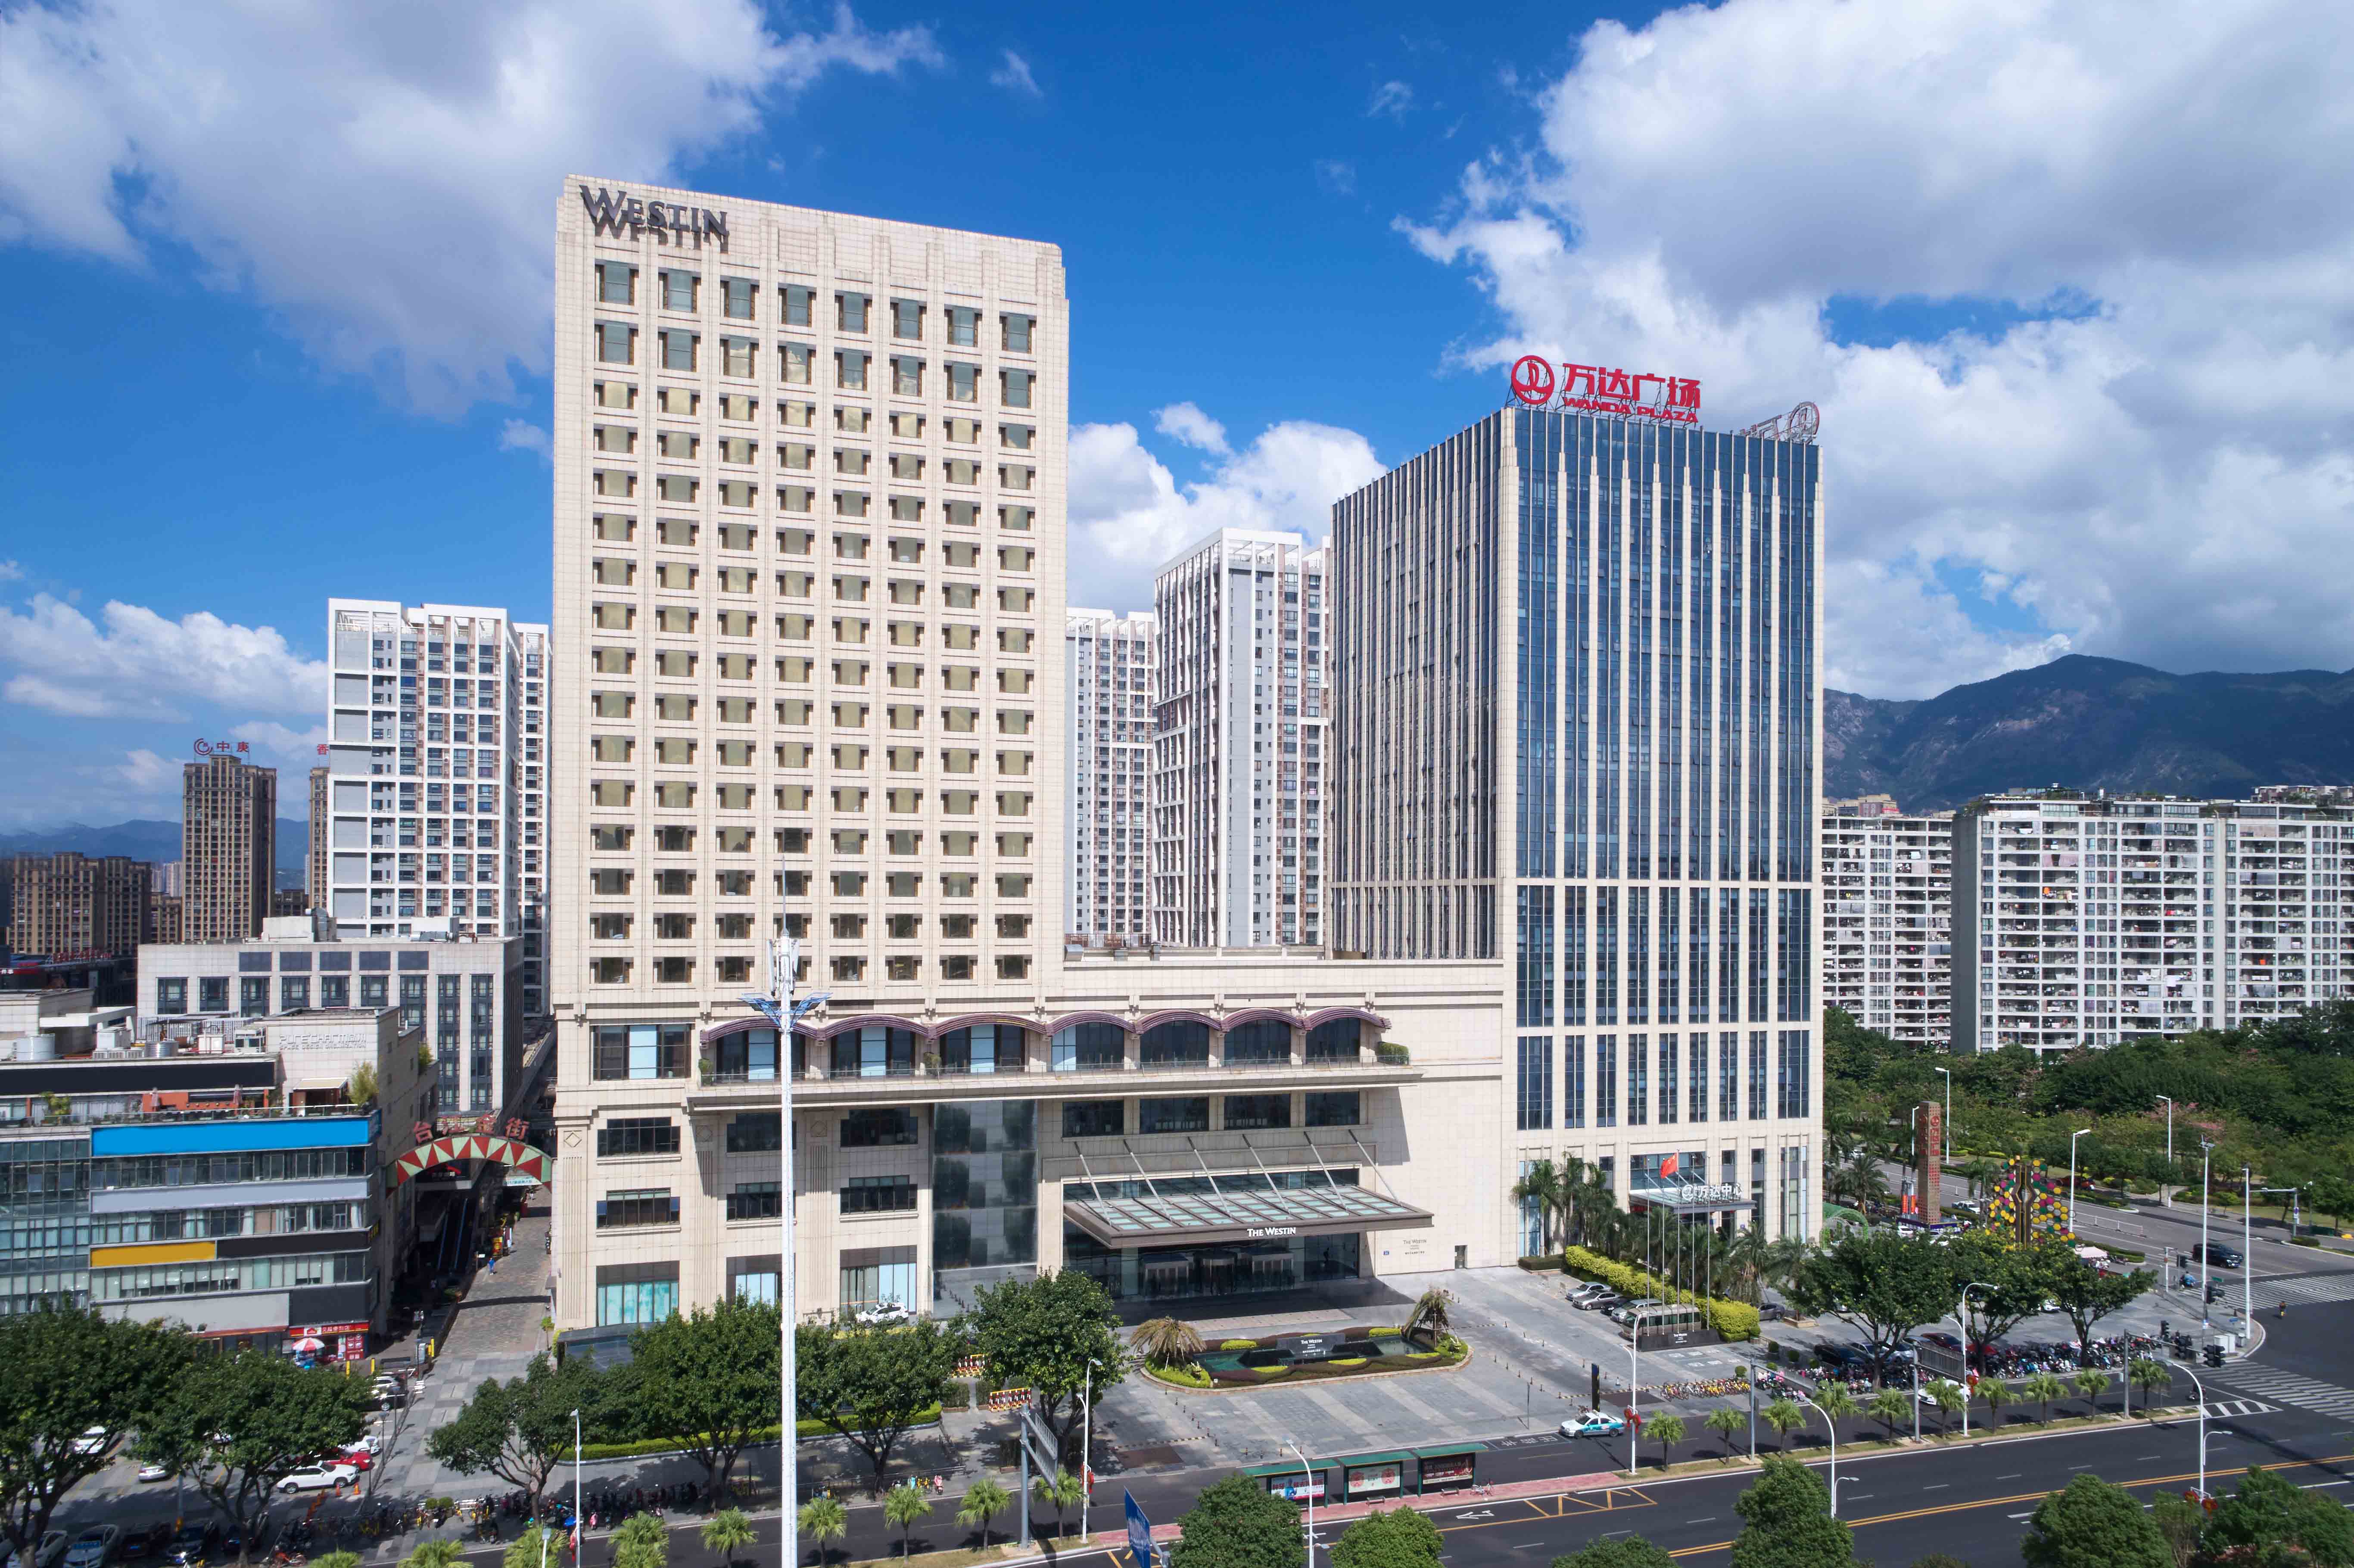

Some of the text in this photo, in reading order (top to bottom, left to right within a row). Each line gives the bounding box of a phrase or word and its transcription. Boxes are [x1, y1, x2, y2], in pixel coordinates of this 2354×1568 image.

[579, 184, 729, 235] WESTIN
[1563, 363, 1700, 408] 万达广场
[1563, 396, 1698, 423] WANDA PLAZA
[414, 1114, 529, 1142] 台江金街
[1247, 1226, 1296, 1237] THE WESTIN
